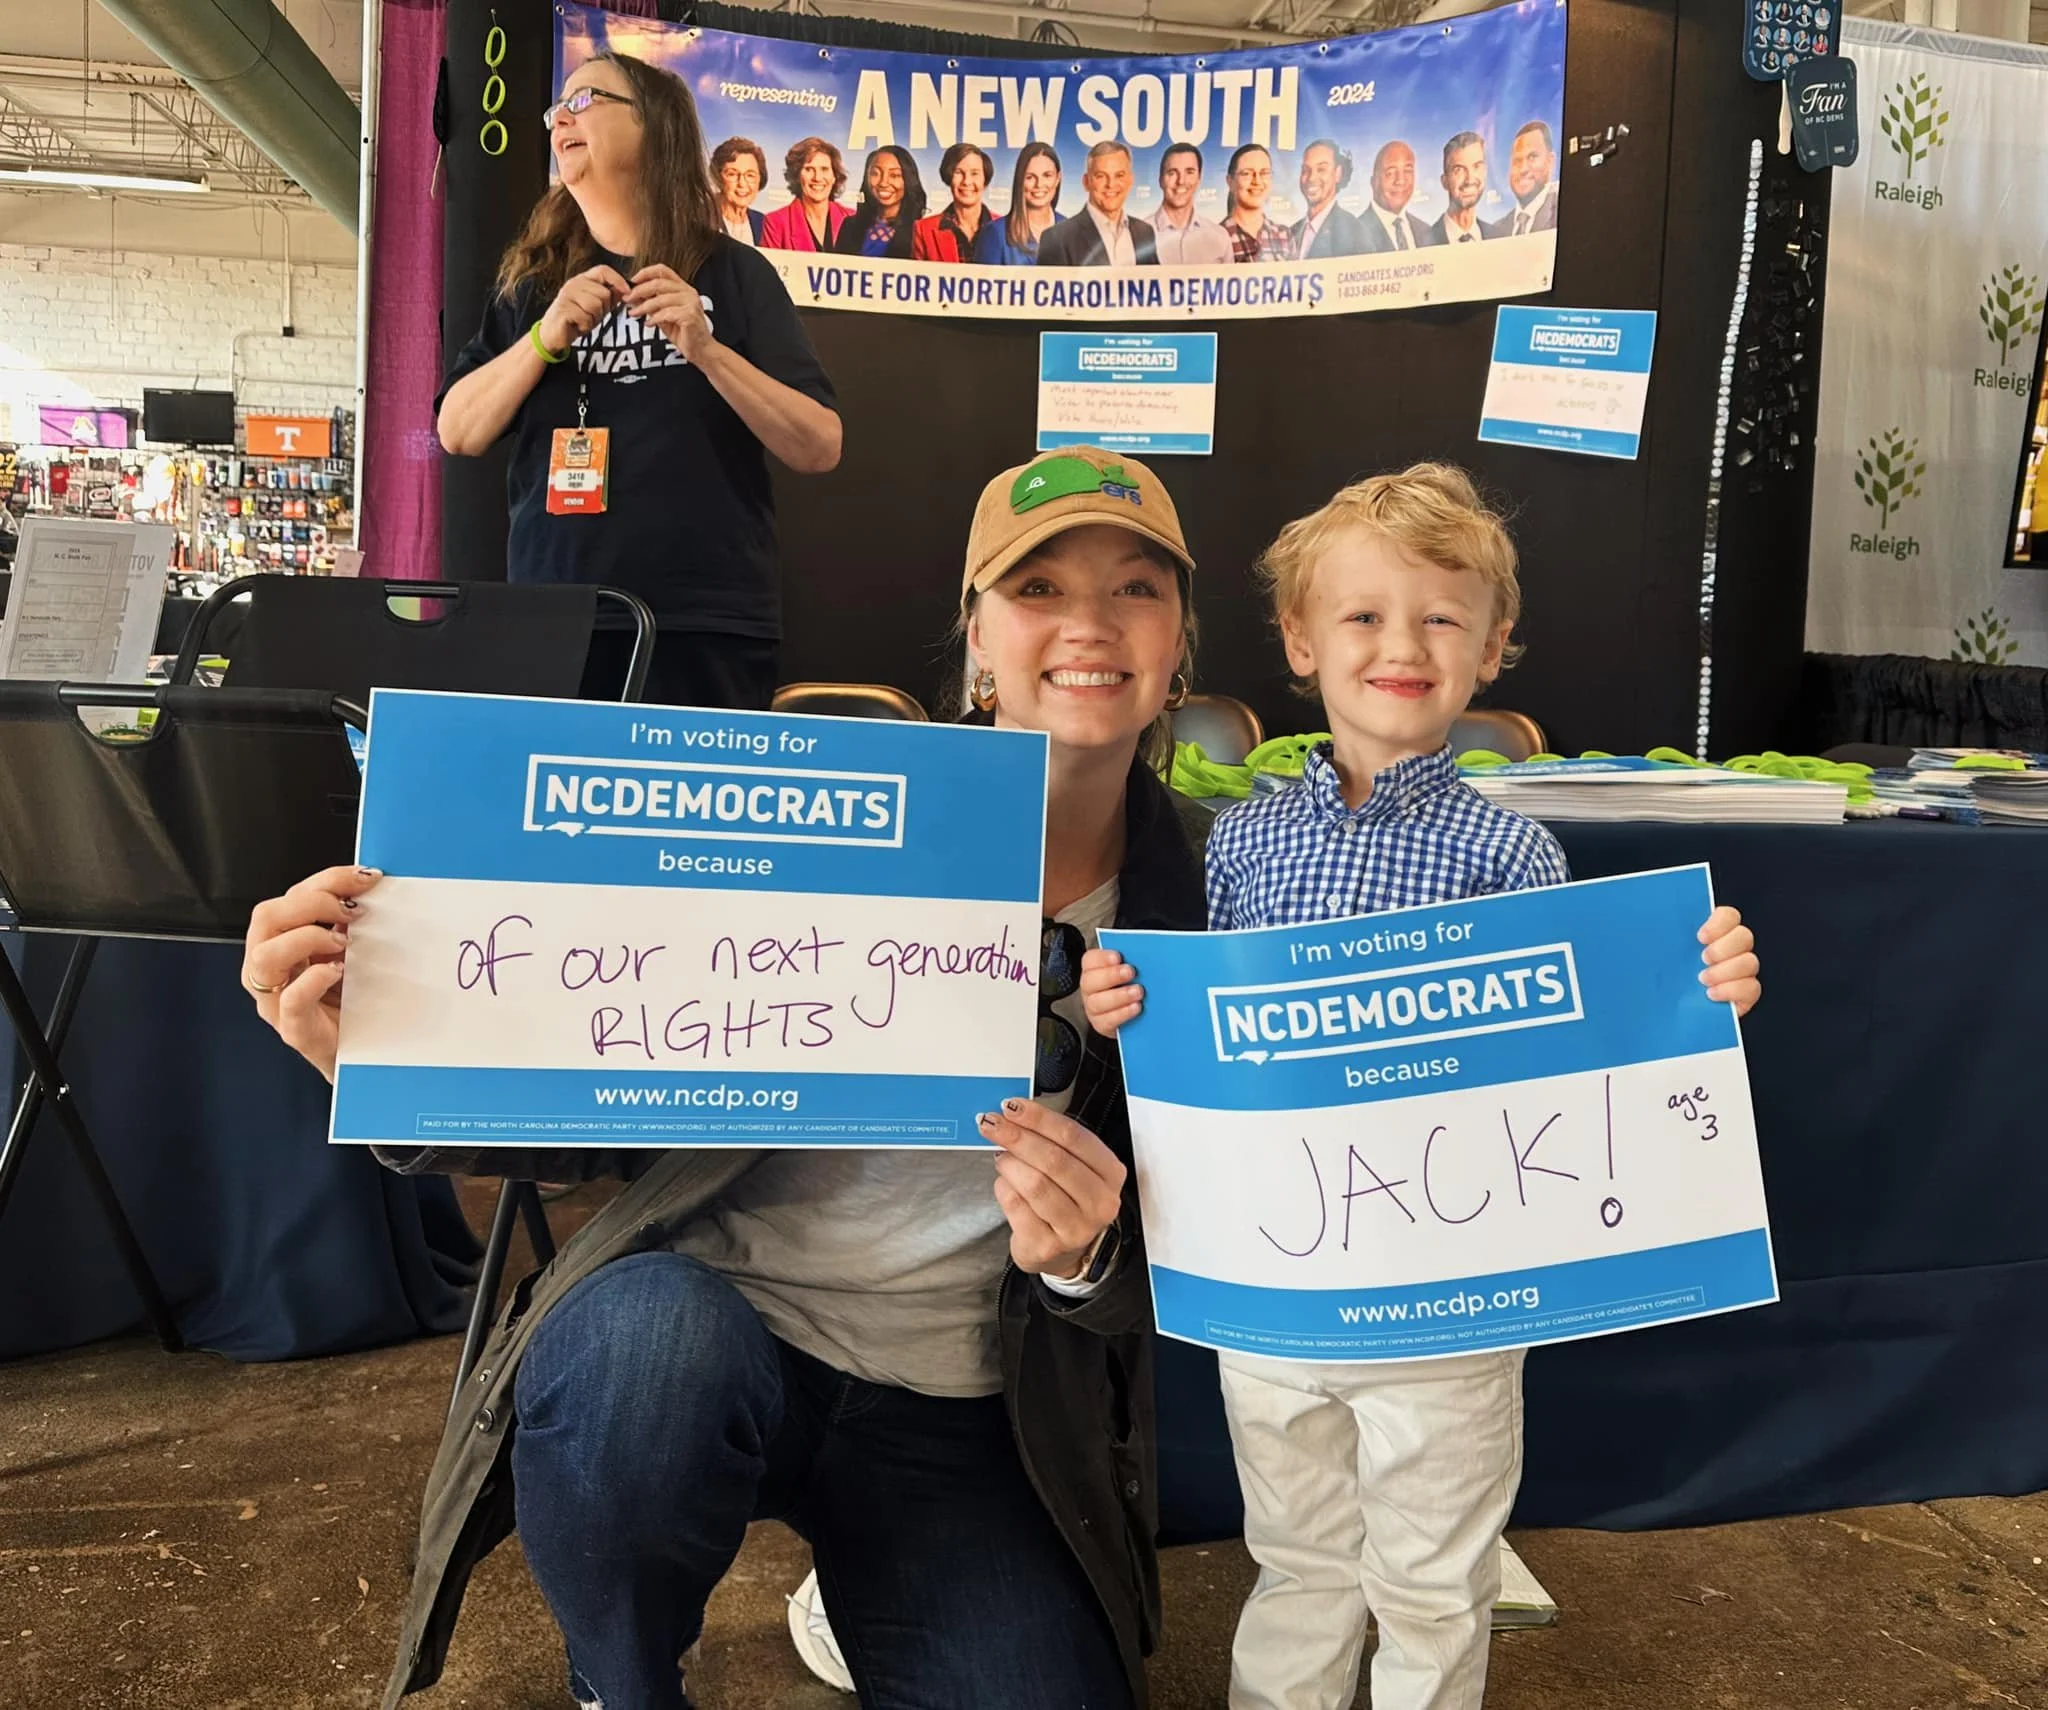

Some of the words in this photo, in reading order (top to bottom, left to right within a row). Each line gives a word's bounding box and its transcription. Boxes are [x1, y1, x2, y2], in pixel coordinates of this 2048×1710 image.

[719, 80, 838, 113] representing
[848, 70, 896, 150] A
[909, 72, 1066, 149] NEW
[1075, 66, 1299, 151] SOUTH
[1327, 80, 1376, 107] 2024
[1799, 83, 1849, 115] Fan
[1804, 118, 1814, 126] OF
[1875, 181, 1944, 211] Raleigh
[807, 266, 874, 300] VOTE
[881, 271, 931, 303] FOR
[938, 275, 1027, 308] NORTH
[1033, 277, 1162, 309] CAROLINA
[1169, 272, 1325, 308] DEMOCRATS
[1535, 330, 1617, 350] NCDEMOCRATS
[1084, 353, 1174, 366] NCDEMOCRATS
[1850, 533, 1920, 561] Raleigh
[630, 723, 672, 746] I'm
[682, 729, 770, 755] voting
[779, 731, 818, 754] for
[545, 774, 891, 830] NCDEMOCRATS
[658, 849, 773, 875] because
[457, 915, 533, 996] of
[560, 943, 666, 990] our
[711, 926, 845, 980] next
[1290, 943, 1332, 966] I'm
[1340, 929, 1428, 959] voting
[1435, 921, 1475, 945] for
[1225, 964, 1567, 1044] NCDEMOCRATS
[591, 999, 834, 1060] RIGHTS
[1345, 1056, 1461, 1088] because
[595, 1085, 799, 1113] www.ncdp.org
[1667, 1085, 1710, 1121] age
[423, 1120, 441, 1128] PAID
[519, 1122, 559, 1130] CAROLINA
[560, 1122, 610, 1130] DEMOCRATIC
[728, 1124, 775, 1132] AUTHORIZED
[776, 1124, 786, 1132] BY
[788, 1124, 803, 1132] ANY
[805, 1124, 846, 1132] CANDIDATE
[1701, 1114, 1719, 1141] 3
[1259, 1074, 1624, 1257] JACK!
[1209, 1327, 1222, 1336] PAID
[1257, 1336, 1279, 1344] NORTH
[1280, 1338, 1314, 1347] CAROLINA
[1316, 1340, 1361, 1348] DEMOCRATIC
[1475, 1324, 1522, 1337] AUTHORIZED
[1524, 1322, 1535, 1330] BY
[1535, 1319, 1551, 1329] ANY
[1552, 1313, 1593, 1326] CANDIDATE
[1594, 1311, 1605, 1319] OR
[1606, 1302, 1654, 1317] CANDIDATE'S
[1655, 1294, 1696, 1308] COMMITTEE
[1338, 1284, 1541, 1326] www.ncdp.org
